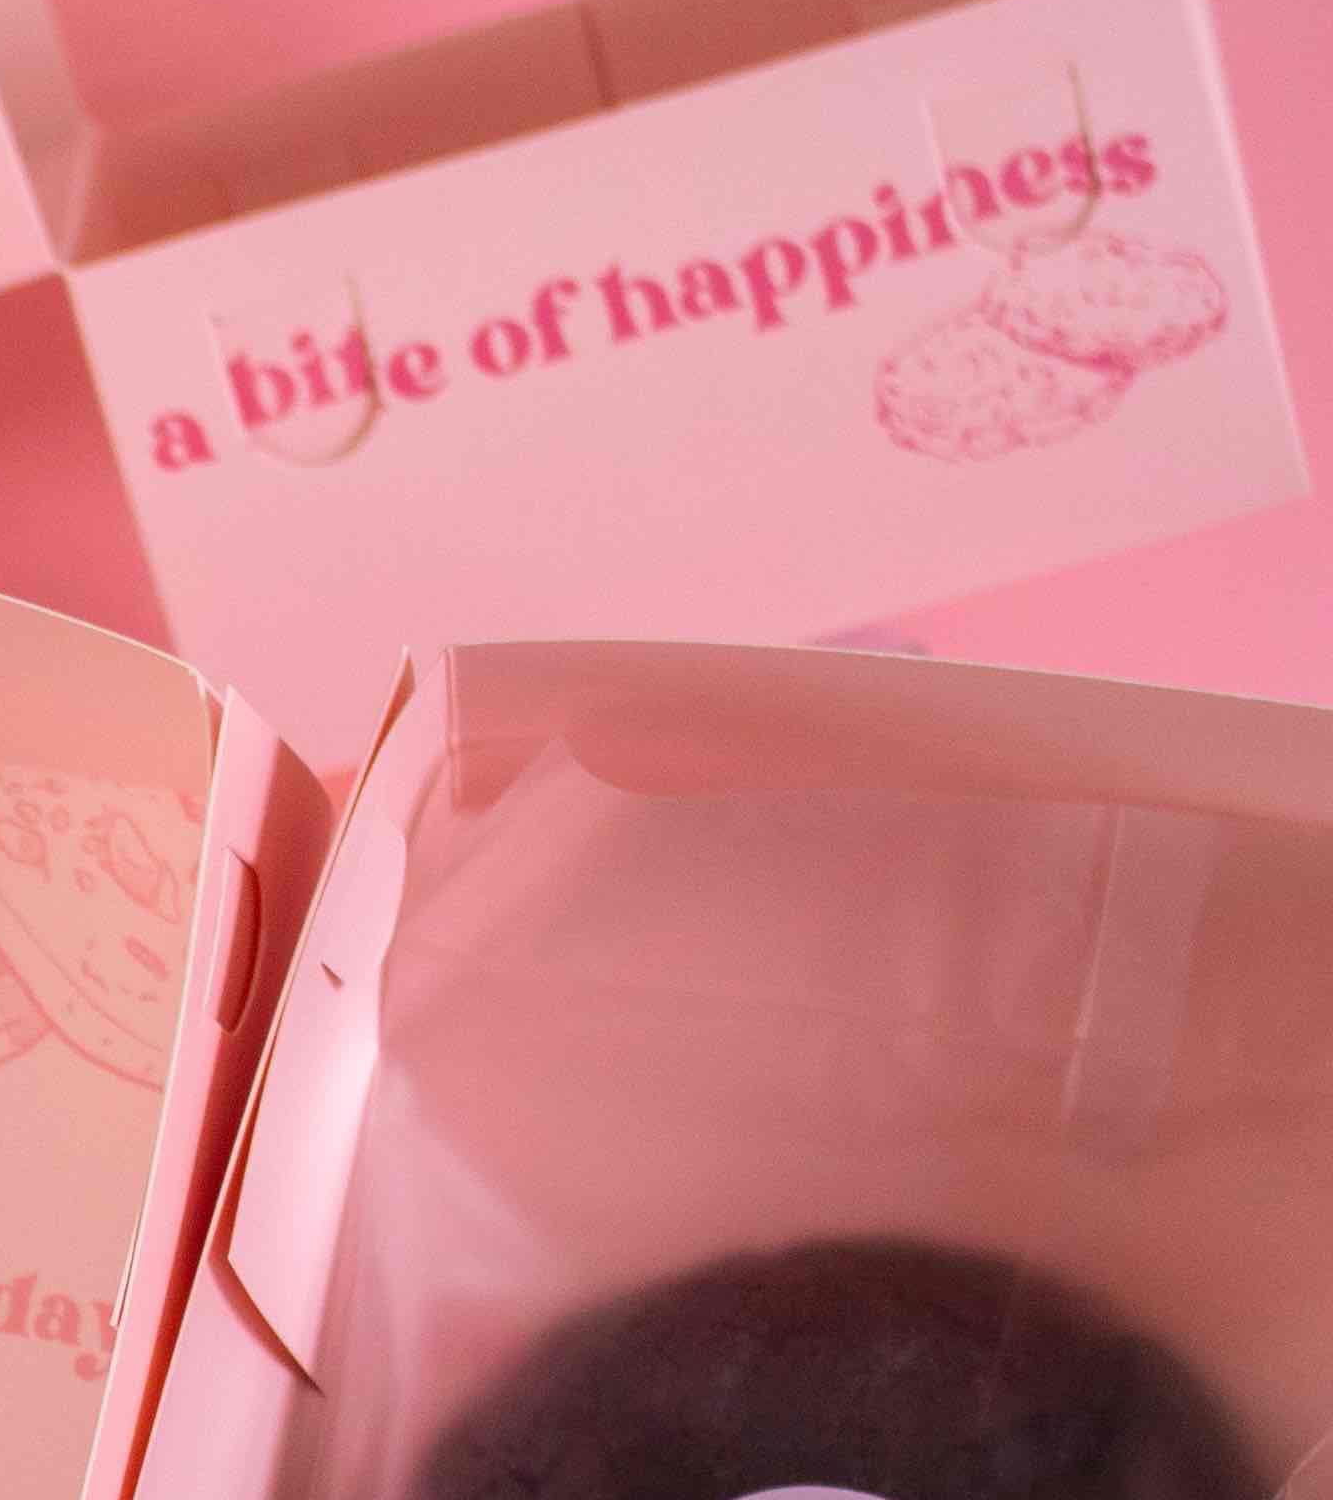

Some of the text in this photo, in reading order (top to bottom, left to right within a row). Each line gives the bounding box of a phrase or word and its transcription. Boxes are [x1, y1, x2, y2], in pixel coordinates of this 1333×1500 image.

[148, 129, 1160, 475] a bite of happiness
